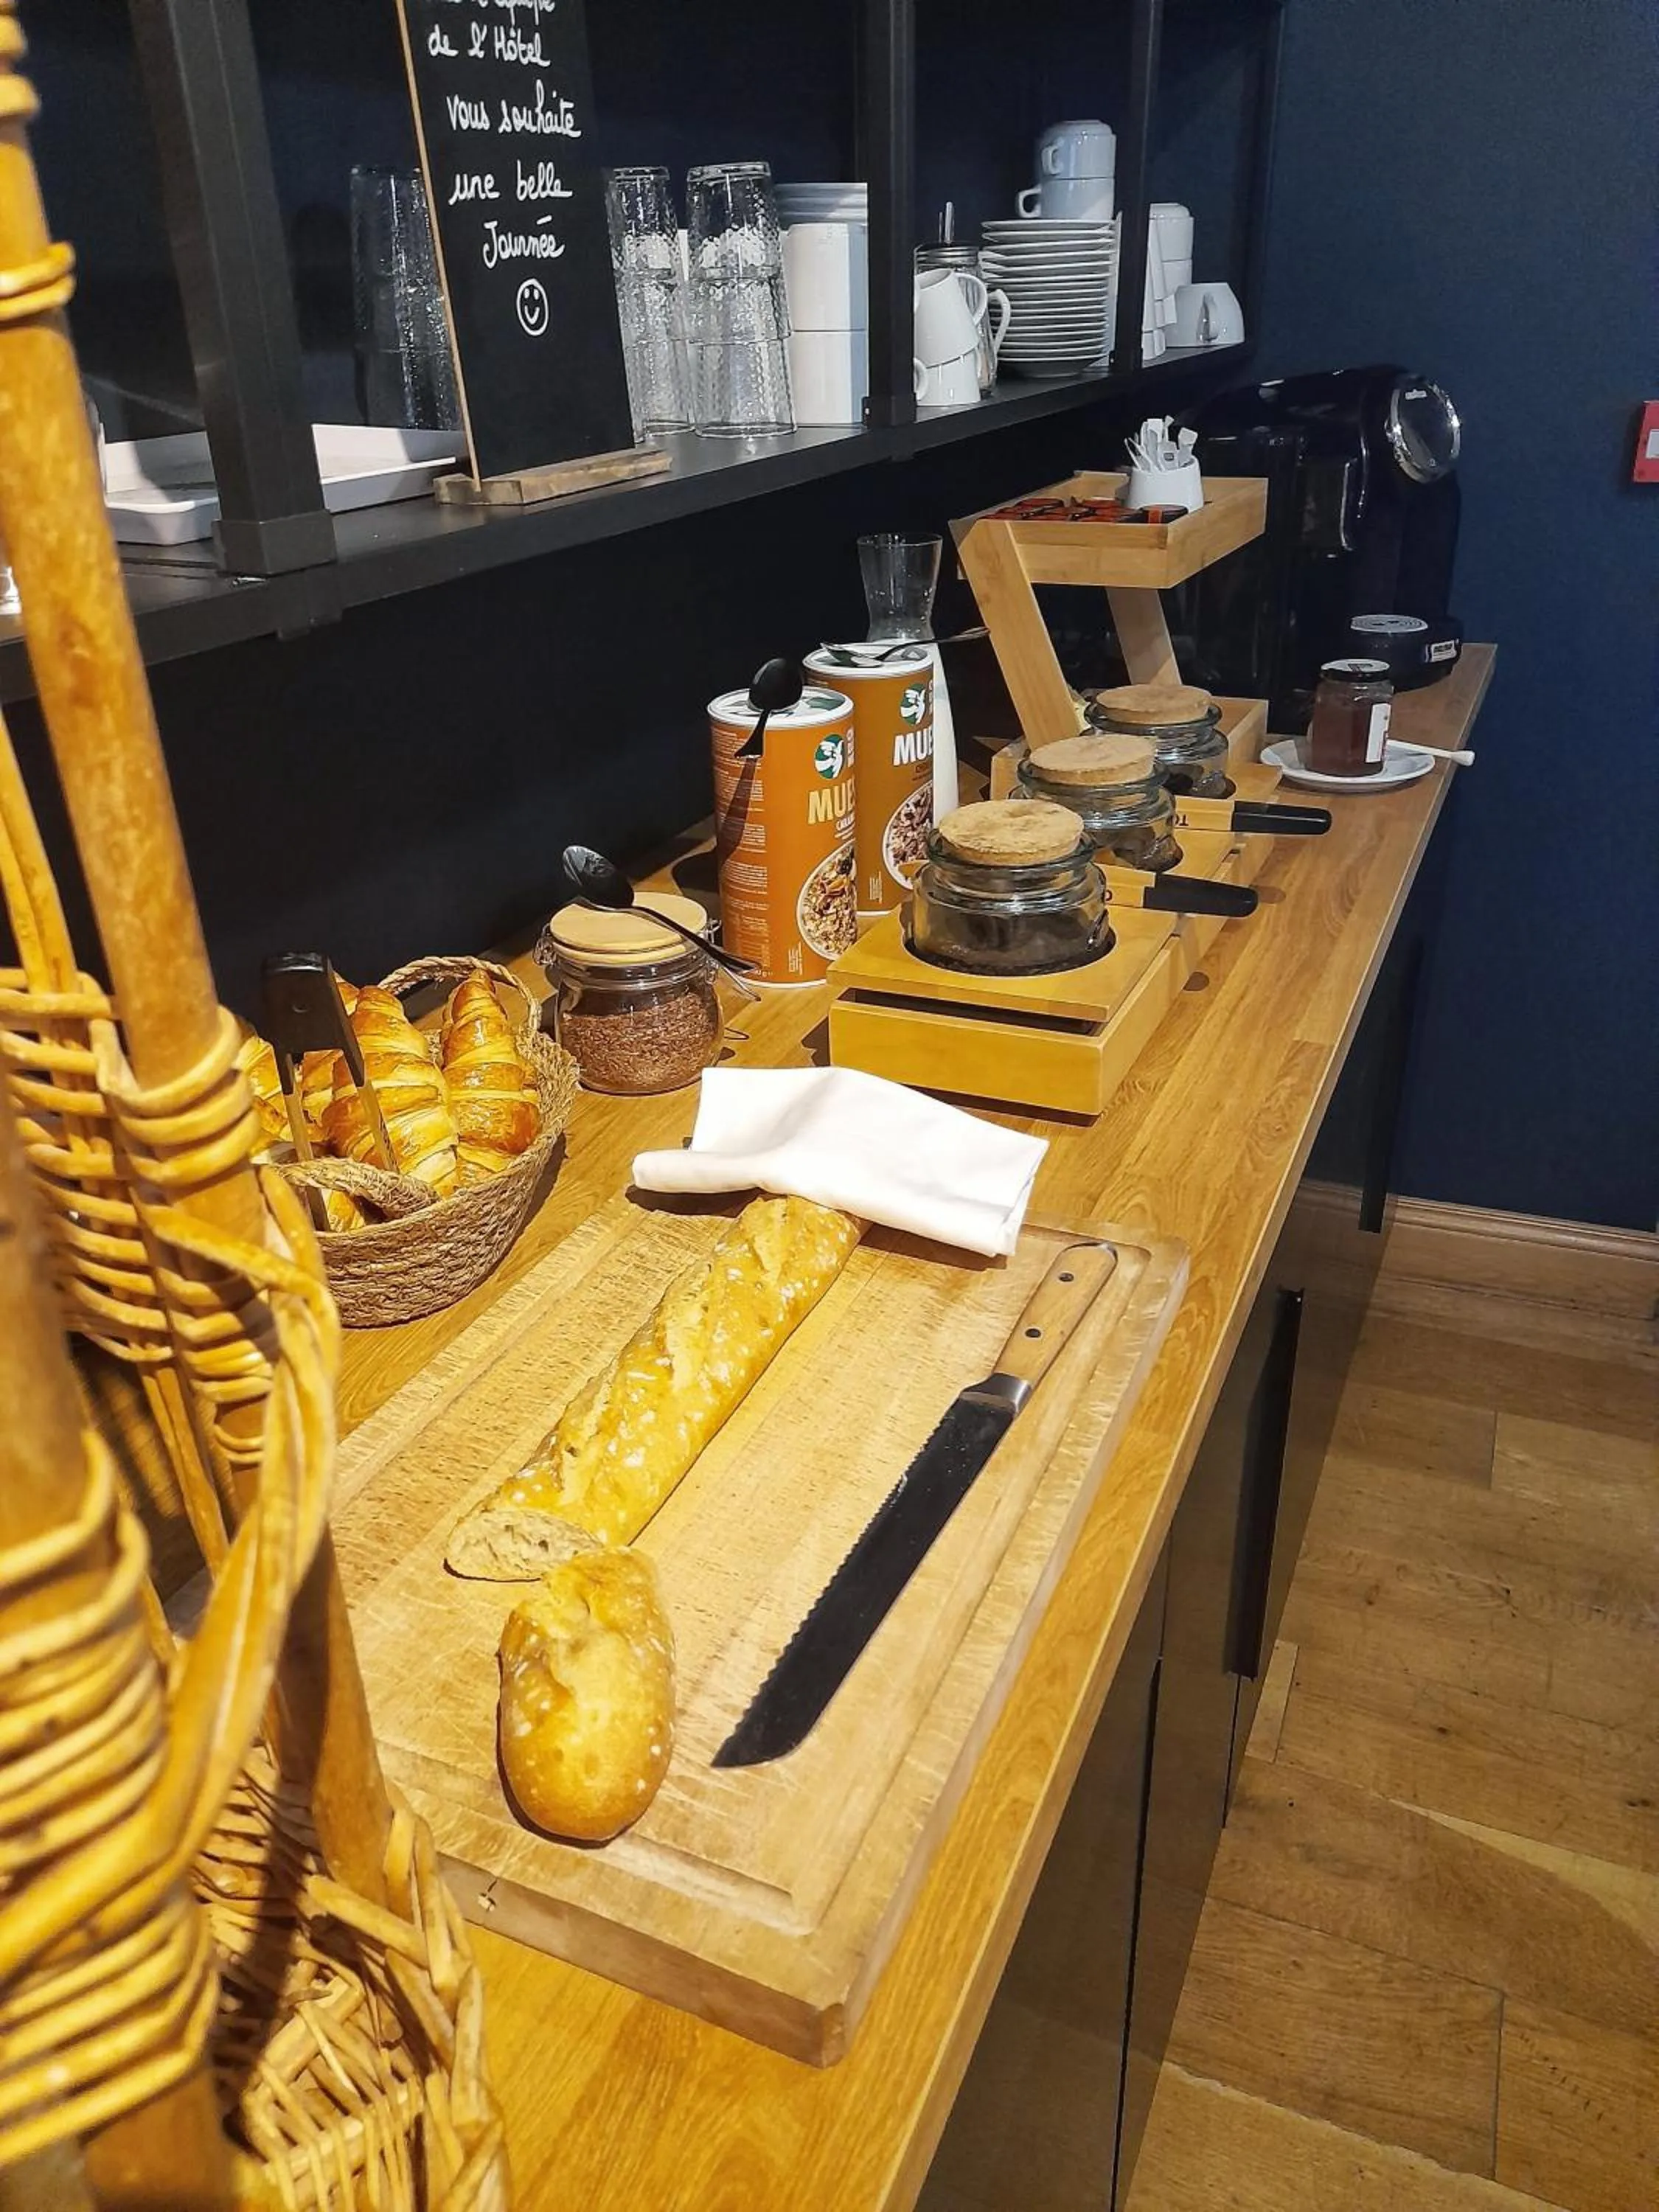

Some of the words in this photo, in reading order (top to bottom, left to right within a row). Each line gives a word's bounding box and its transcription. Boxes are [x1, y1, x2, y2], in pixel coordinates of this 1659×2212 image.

[428, 23, 459, 57] de
[498, 79, 582, 138] souhaite
[448, 173, 501, 206] une
[516, 159, 573, 201] belle
[483, 215, 566, 269] Journée
[808, 774, 856, 824] MUE
